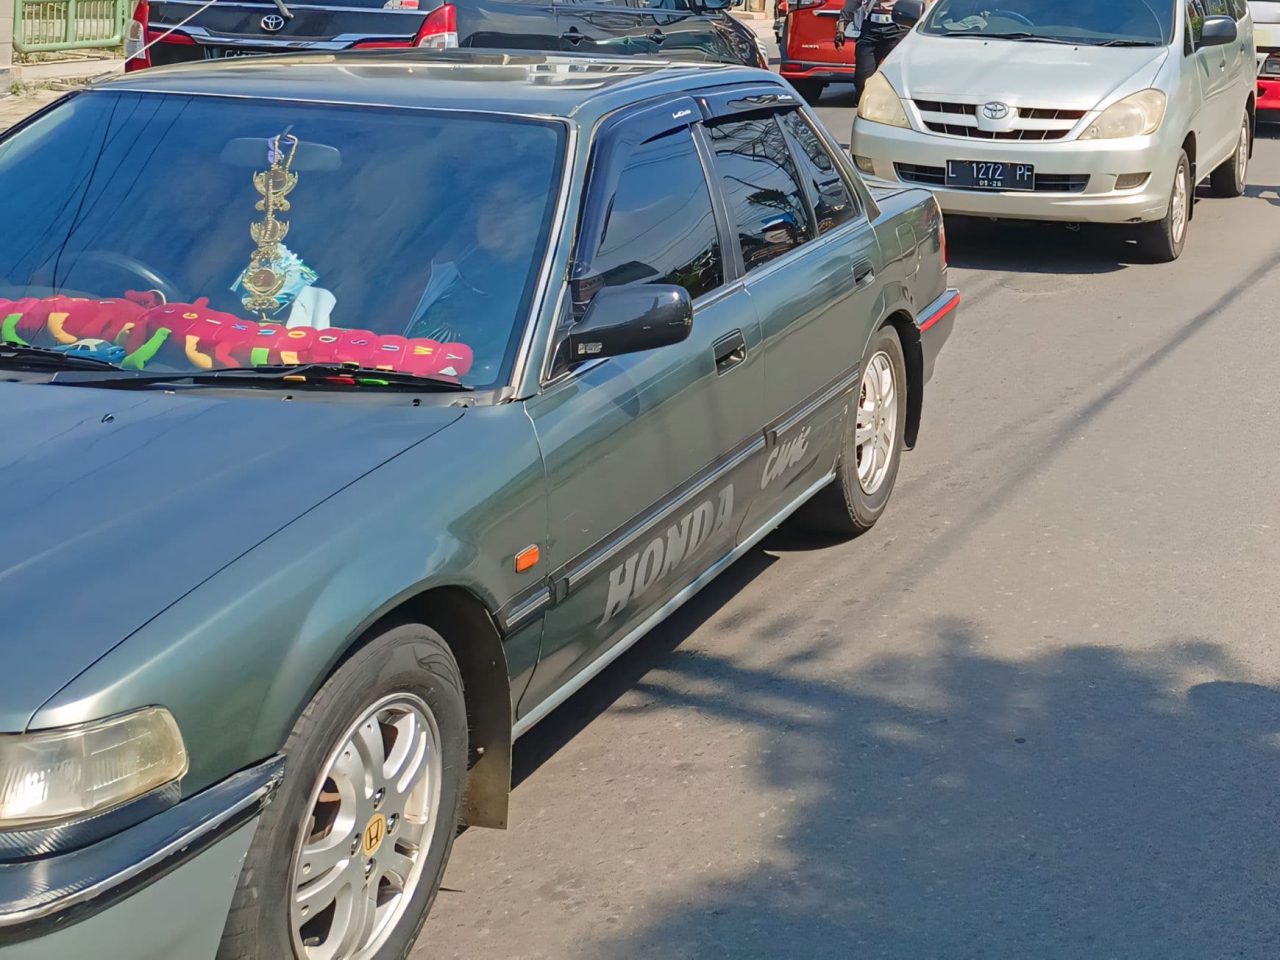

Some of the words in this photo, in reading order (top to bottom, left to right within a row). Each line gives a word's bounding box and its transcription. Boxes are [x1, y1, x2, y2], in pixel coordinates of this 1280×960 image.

[948, 161, 957, 177] L
[972, 163, 1004, 180] 1272
[1016, 165, 1032, 181] PF
[597, 483, 735, 630] HONDA
